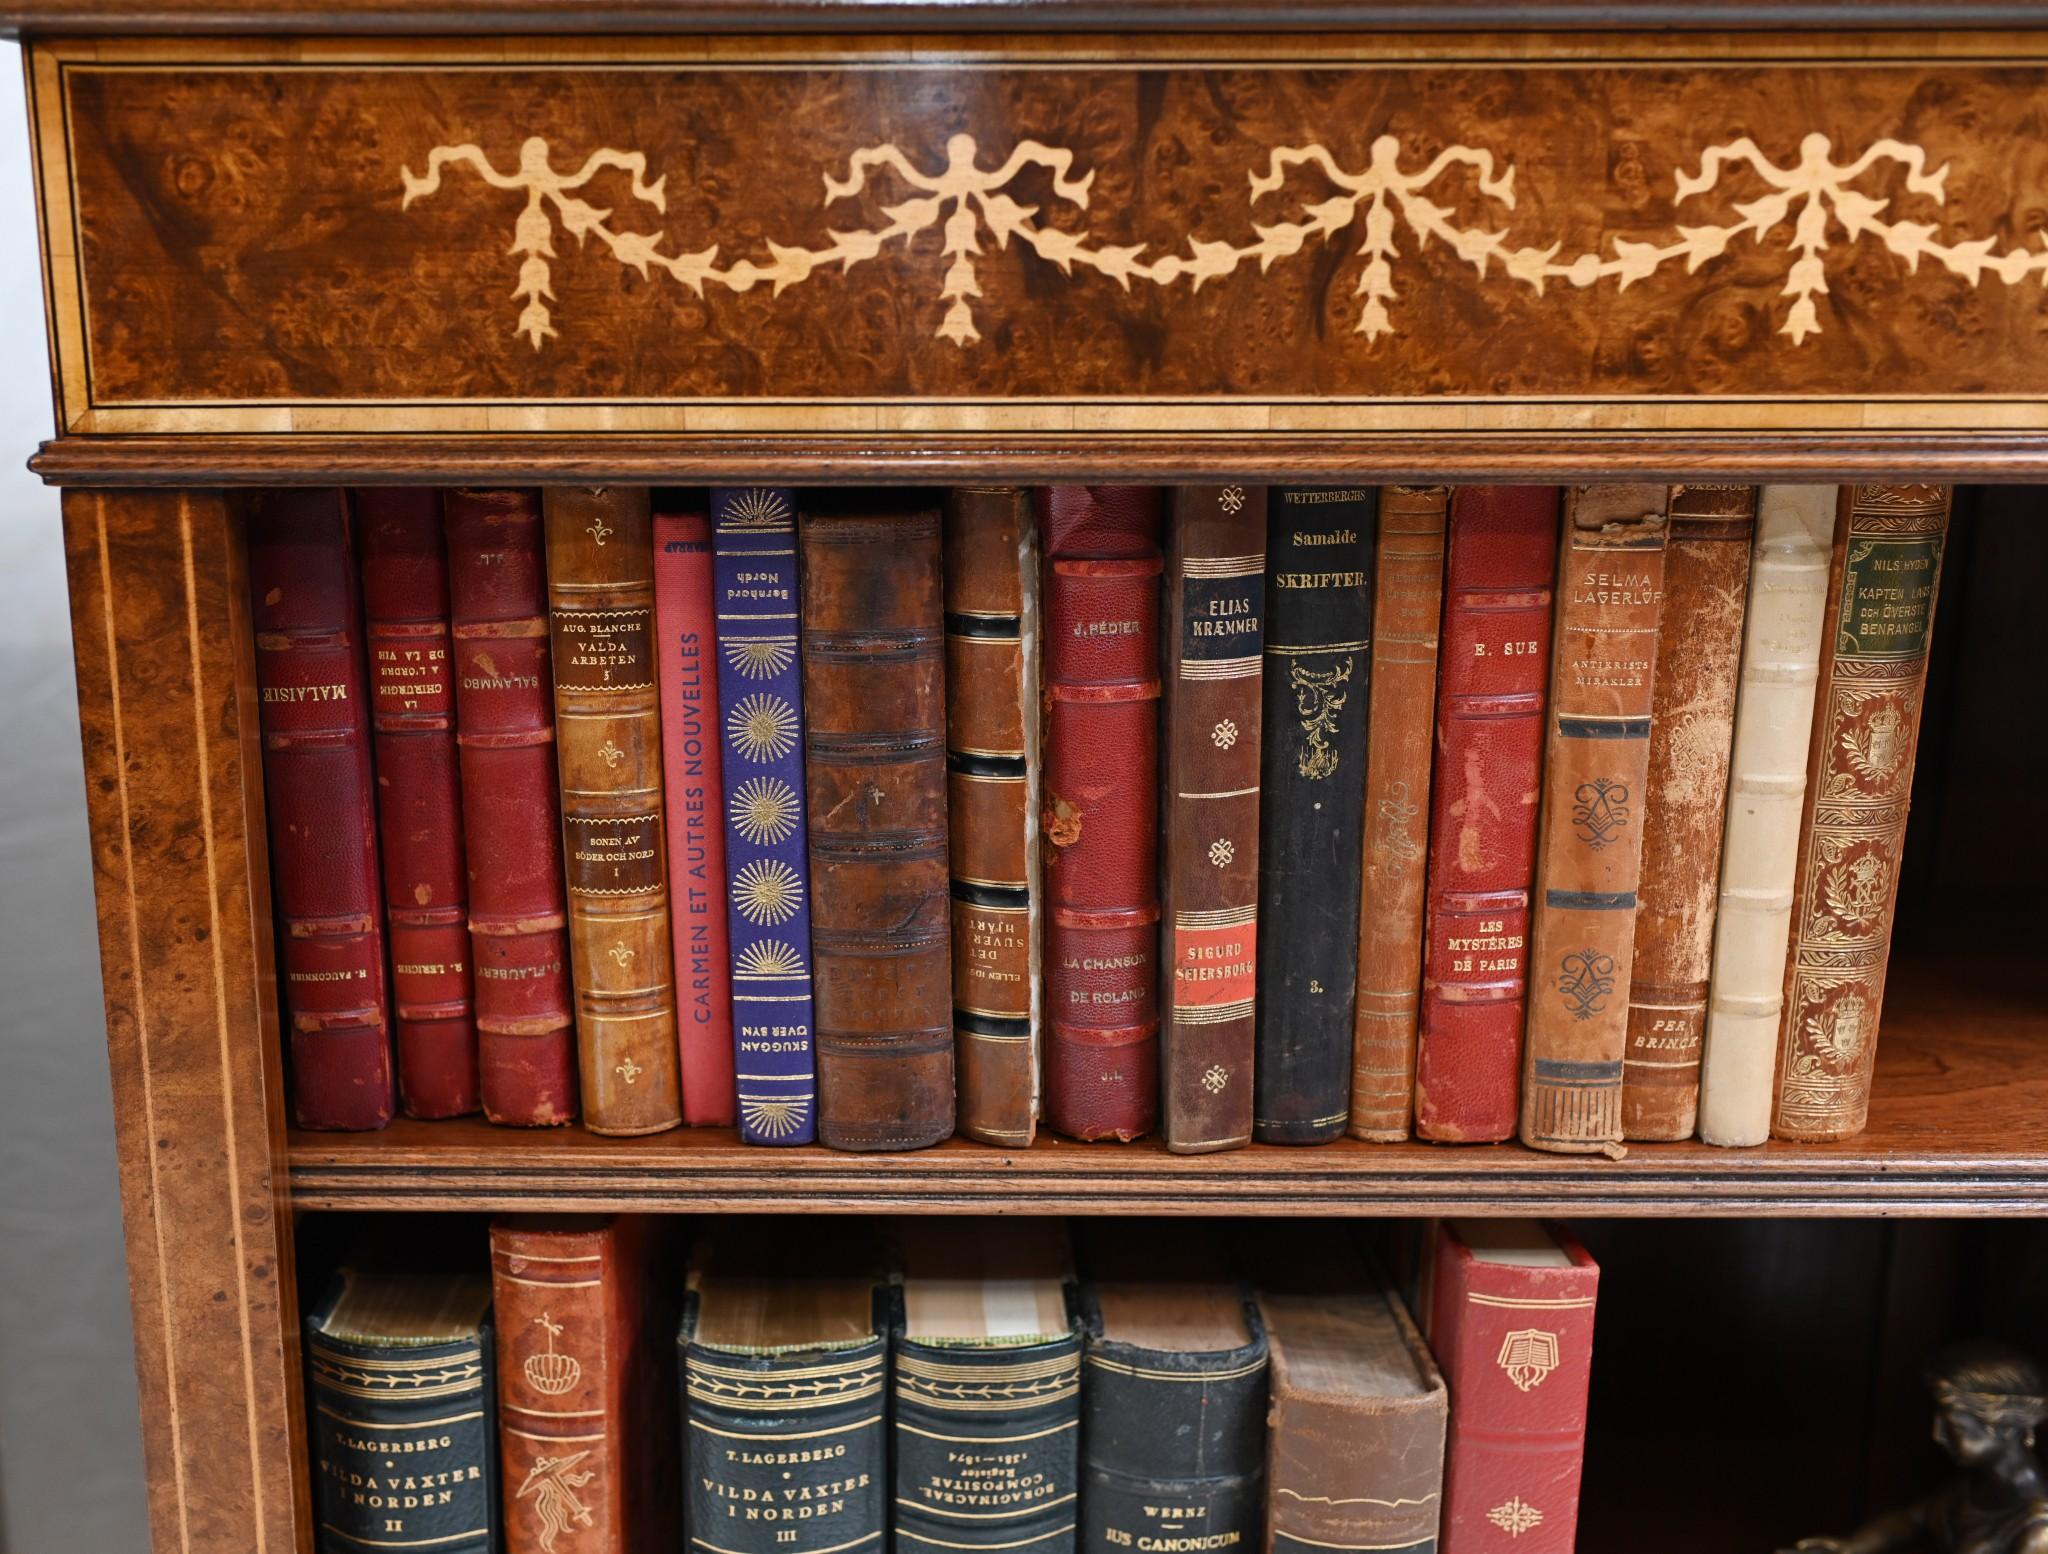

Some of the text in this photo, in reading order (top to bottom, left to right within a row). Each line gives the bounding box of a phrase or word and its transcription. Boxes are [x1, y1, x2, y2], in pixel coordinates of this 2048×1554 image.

[1284, 489, 1366, 504] WETTERBERGHS
[1873, 559, 1901, 571] NILS
[737, 572, 779, 584] Nordh
[1583, 573, 1652, 587] SELMA
[1574, 588, 1663, 605] LAGERLÖF
[1858, 588, 1904, 600] KAPTEN
[1209, 598, 1250, 617] ELIAS
[1860, 603, 1926, 617] OCH ÖVERSTE
[562, 623, 642, 634] AUG. BLANCHE
[1193, 617, 1258, 637] KRÆMMER
[1860, 622, 1923, 635] BENRANGEL
[577, 643, 628, 652] VALDA
[1474, 641, 1538, 657] E. SUE
[405, 651, 421, 661] LA
[429, 651, 445, 660] DE
[571, 655, 637, 665] ARBETEN
[1572, 661, 1649, 671] ANTIKRISTS
[463, 676, 539, 689] SALAMMBO
[1575, 677, 1643, 687] MIRAKLER
[263, 684, 348, 703] MALAISIE
[404, 700, 418, 709] LA
[681, 633, 712, 1024] CARMEN ET AUTRES NOUVELLES
[590, 835, 641, 847] SONEN AV
[575, 849, 654, 862] SÖDER OCH NORD
[1479, 921, 1503, 934] LES
[969, 950, 998, 960] DET
[1187, 943, 1242, 961] SIGURD
[1064, 953, 1146, 970] LA CHANSON
[1453, 958, 1518, 972] DE PARIS
[988, 972, 1021, 982] ELLEN
[1176, 961, 1254, 982] SEIERSBORG
[1309, 979, 1324, 994] 3.
[1070, 987, 1146, 1004] DE ROLAND
[742, 1026, 767, 1037] BYN
[1653, 1020, 1686, 1032] PER
[741, 1040, 808, 1052] SKUGGAN
[1634, 1035, 1698, 1049] BRINCK
[320, 1460, 379, 1490] VILDA
[960, 1468, 1016, 1479] Register
[931, 1473, 1044, 1491] COMPOSITAE
[702, 1478, 775, 1502] VILDA
[354, 1490, 453, 1509] NORDEN
[728, 1499, 845, 1521] I NORDEN
[1143, 1505, 1207, 1519] WERNZ
[385, 1519, 403, 1532] II
[776, 1530, 797, 1542] III
[1105, 1527, 1241, 1552] IUS CANONICUM
